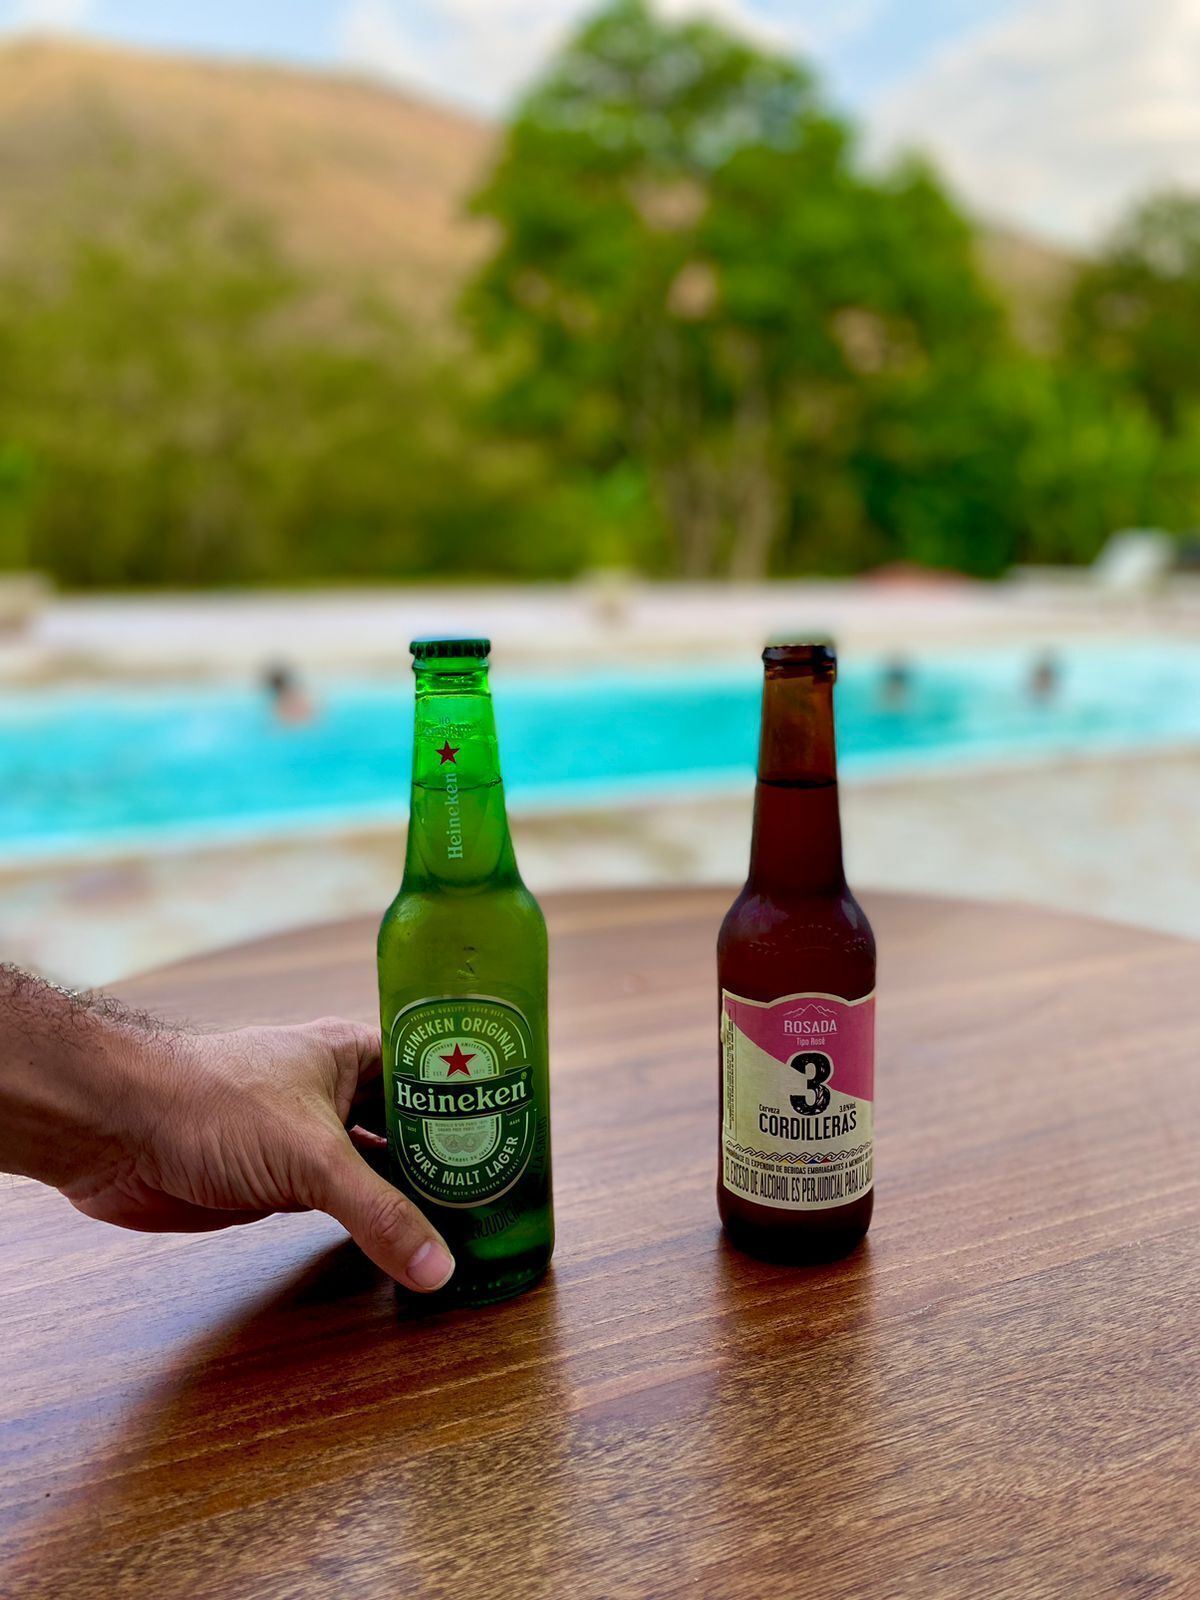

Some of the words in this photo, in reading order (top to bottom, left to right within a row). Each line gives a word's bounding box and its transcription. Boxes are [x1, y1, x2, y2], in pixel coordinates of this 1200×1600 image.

[445, 772, 464, 860] Heineken
[402, 1017, 455, 1066] HEINEKEN
[461, 1017, 517, 1061] ORIGINAL
[784, 1019, 838, 1034] ROSADA
[796, 1037, 809, 1047] Tipo
[396, 1080, 527, 1113] Heineken
[789, 1052, 832, 1116] 3
[758, 1103, 781, 1115] Cerveza
[758, 1110, 857, 1141] CORDILLERAS
[409, 1143, 438, 1179] PURE
[441, 1169, 480, 1186] MALT
[485, 1136, 519, 1178] LAGER
[751, 1159, 775, 1172] EXPENDIO
[776, 1165, 782, 1173] DE
[784, 1166, 806, 1174] BEBIDAS
[807, 1162, 844, 1174] EMBRIAGANTES
[730, 1160, 749, 1192] EXCESO
[750, 1169, 759, 1195] DE
[759, 1173, 790, 1201] ALCOHOL
[791, 1177, 800, 1202] ES
[802, 1173, 843, 1202] PERJUDICIAL
[844, 1168, 858, 1196] PARA
